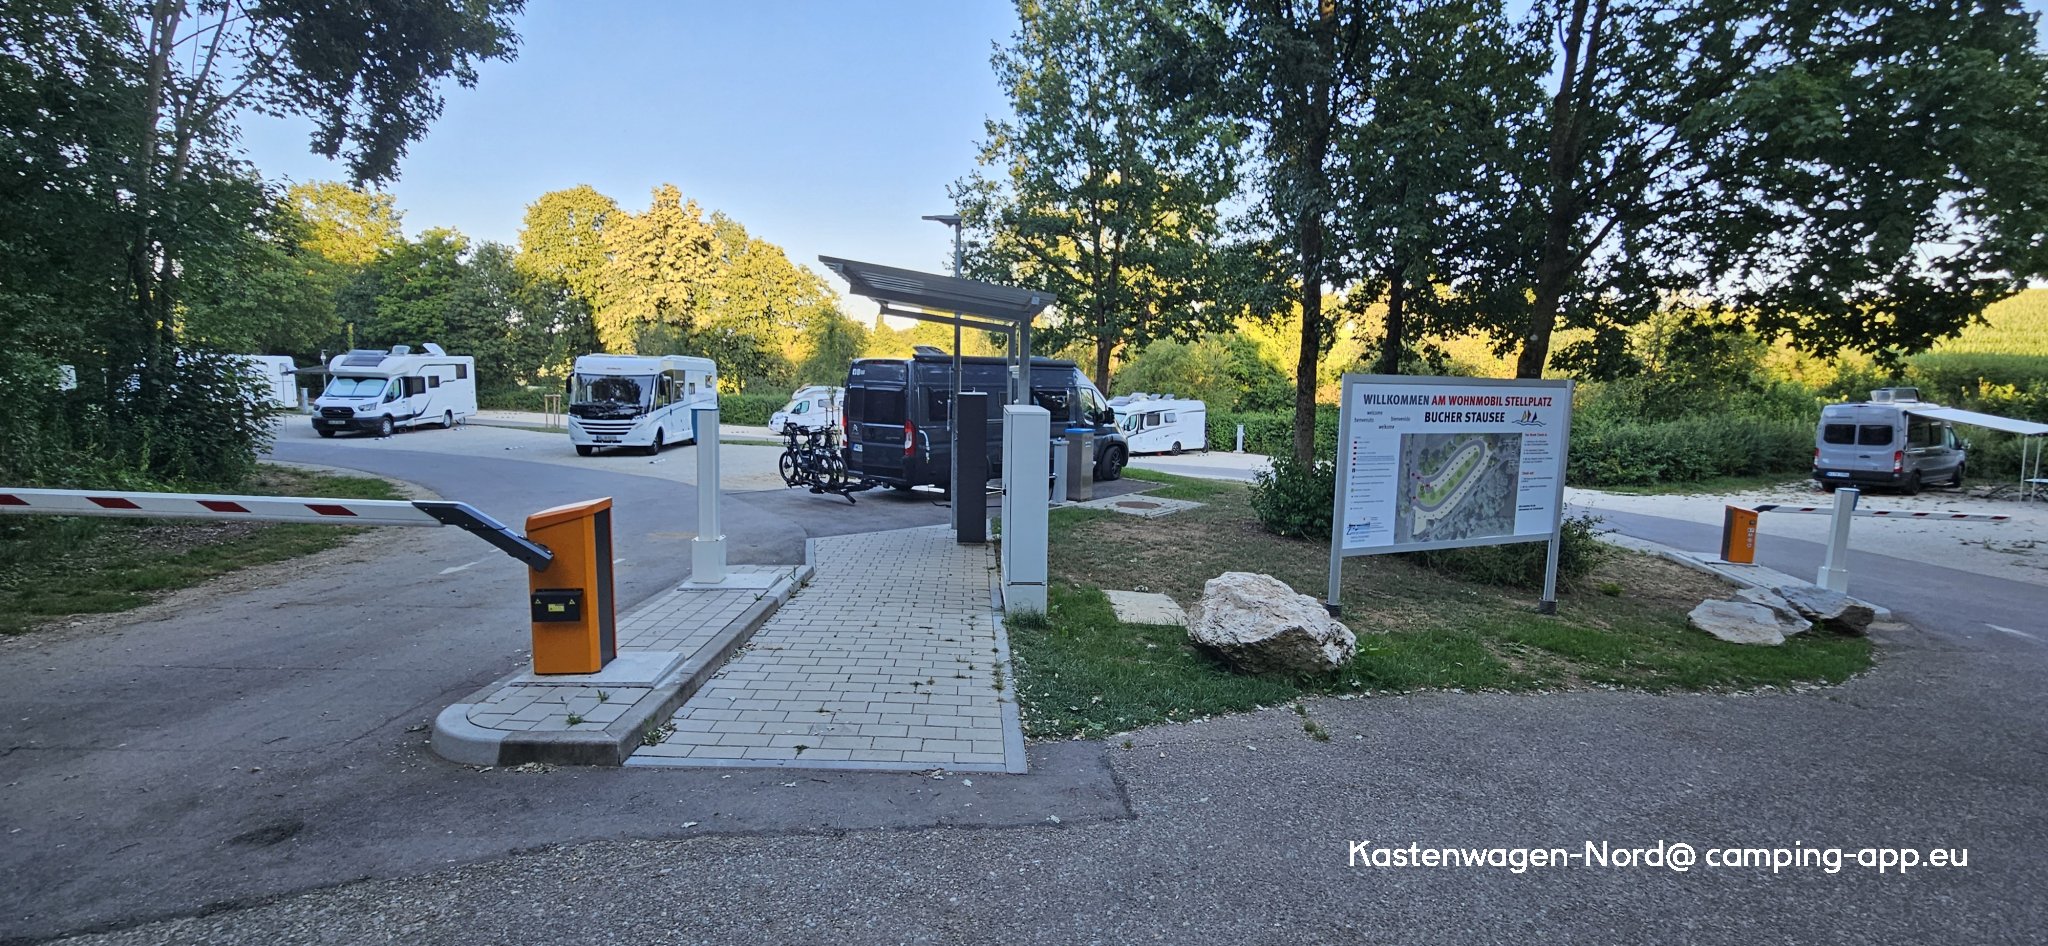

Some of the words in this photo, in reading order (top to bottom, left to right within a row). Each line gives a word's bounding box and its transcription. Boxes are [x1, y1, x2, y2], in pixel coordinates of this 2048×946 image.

[1363, 394, 1430, 406] WILLKOMMEN
[1431, 395, 1446, 406] AM
[1448, 396, 1503, 407] WOHNMOBIL
[1505, 396, 1552, 407] STELLPLATZ
[1424, 412, 1463, 423] BUCHER
[1464, 412, 1505, 423] STAUSEE
